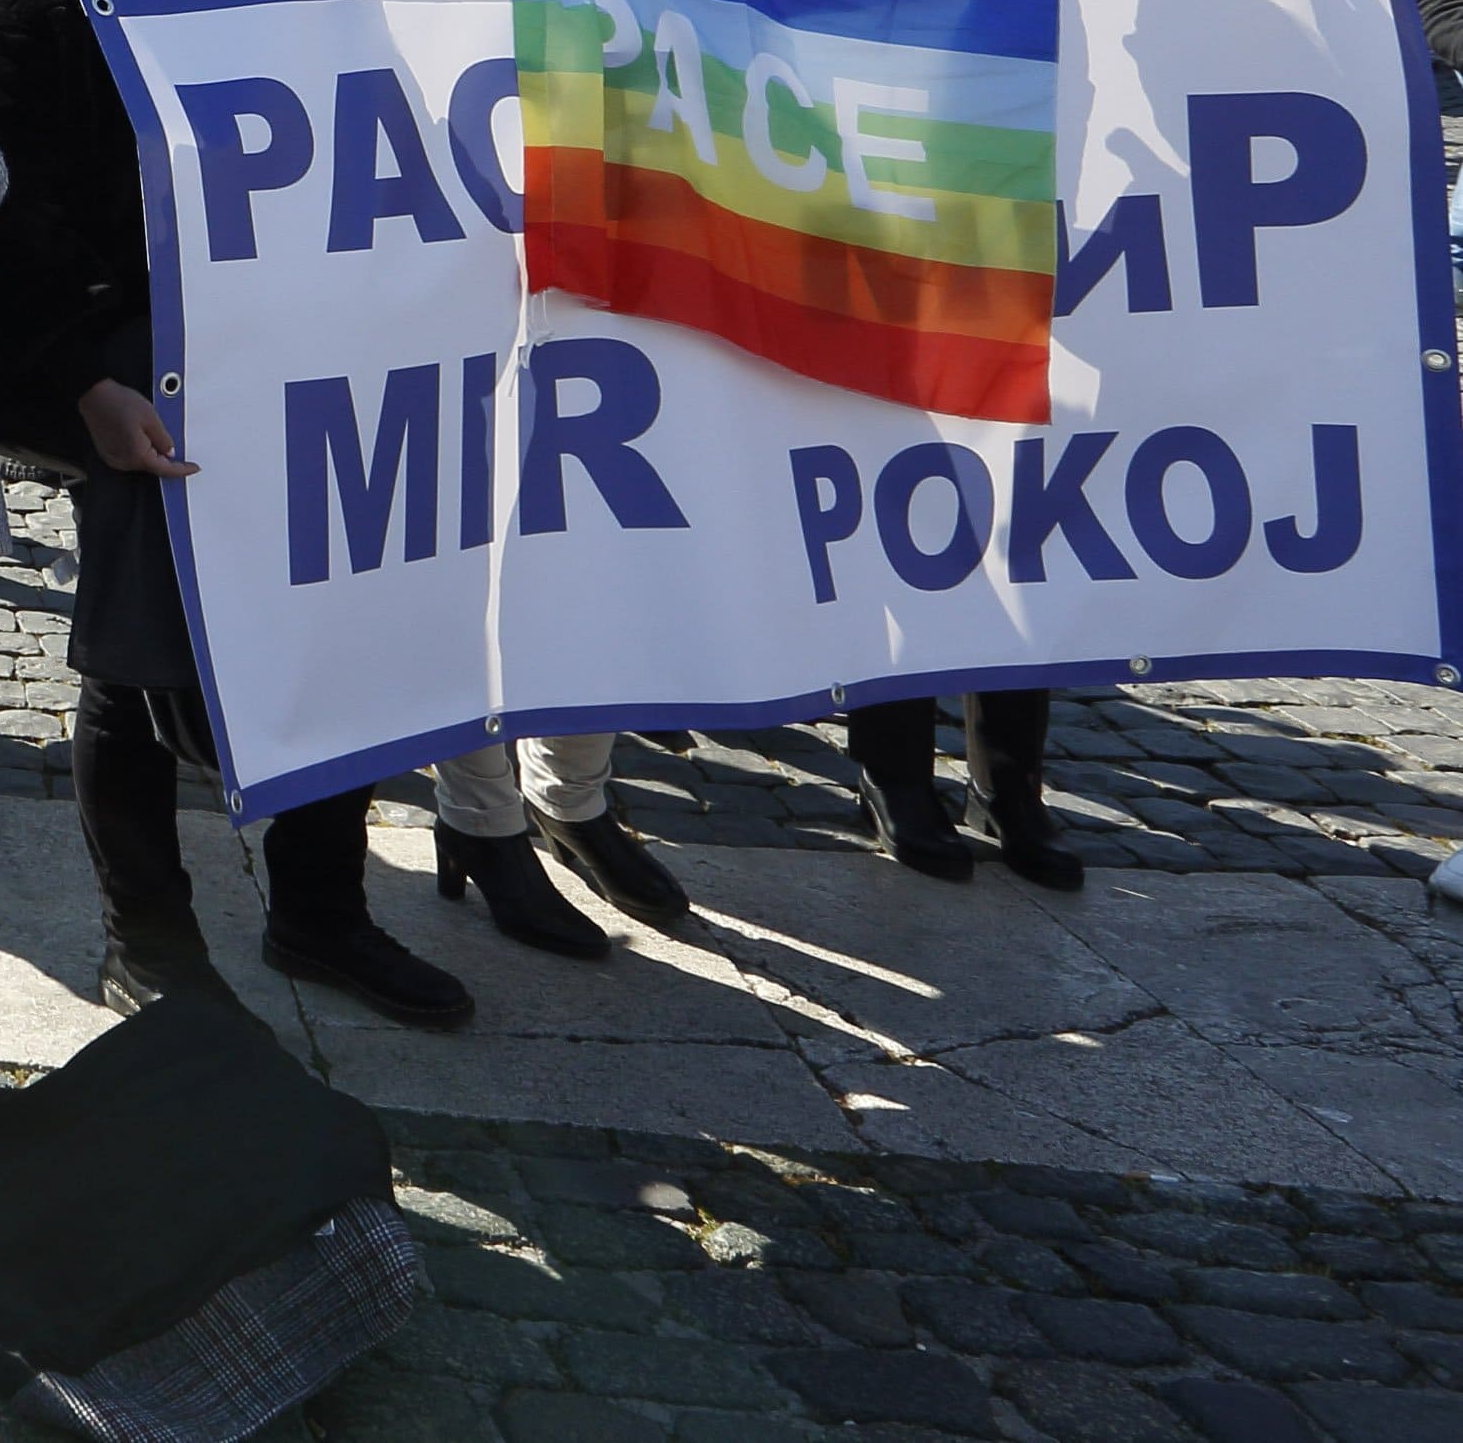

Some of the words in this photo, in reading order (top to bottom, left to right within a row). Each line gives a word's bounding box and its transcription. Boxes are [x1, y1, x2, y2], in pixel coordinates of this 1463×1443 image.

[174, 58, 524, 262] PAC
[285, 338, 690, 586] MIR
[790, 423, 1363, 604] POKOJ
